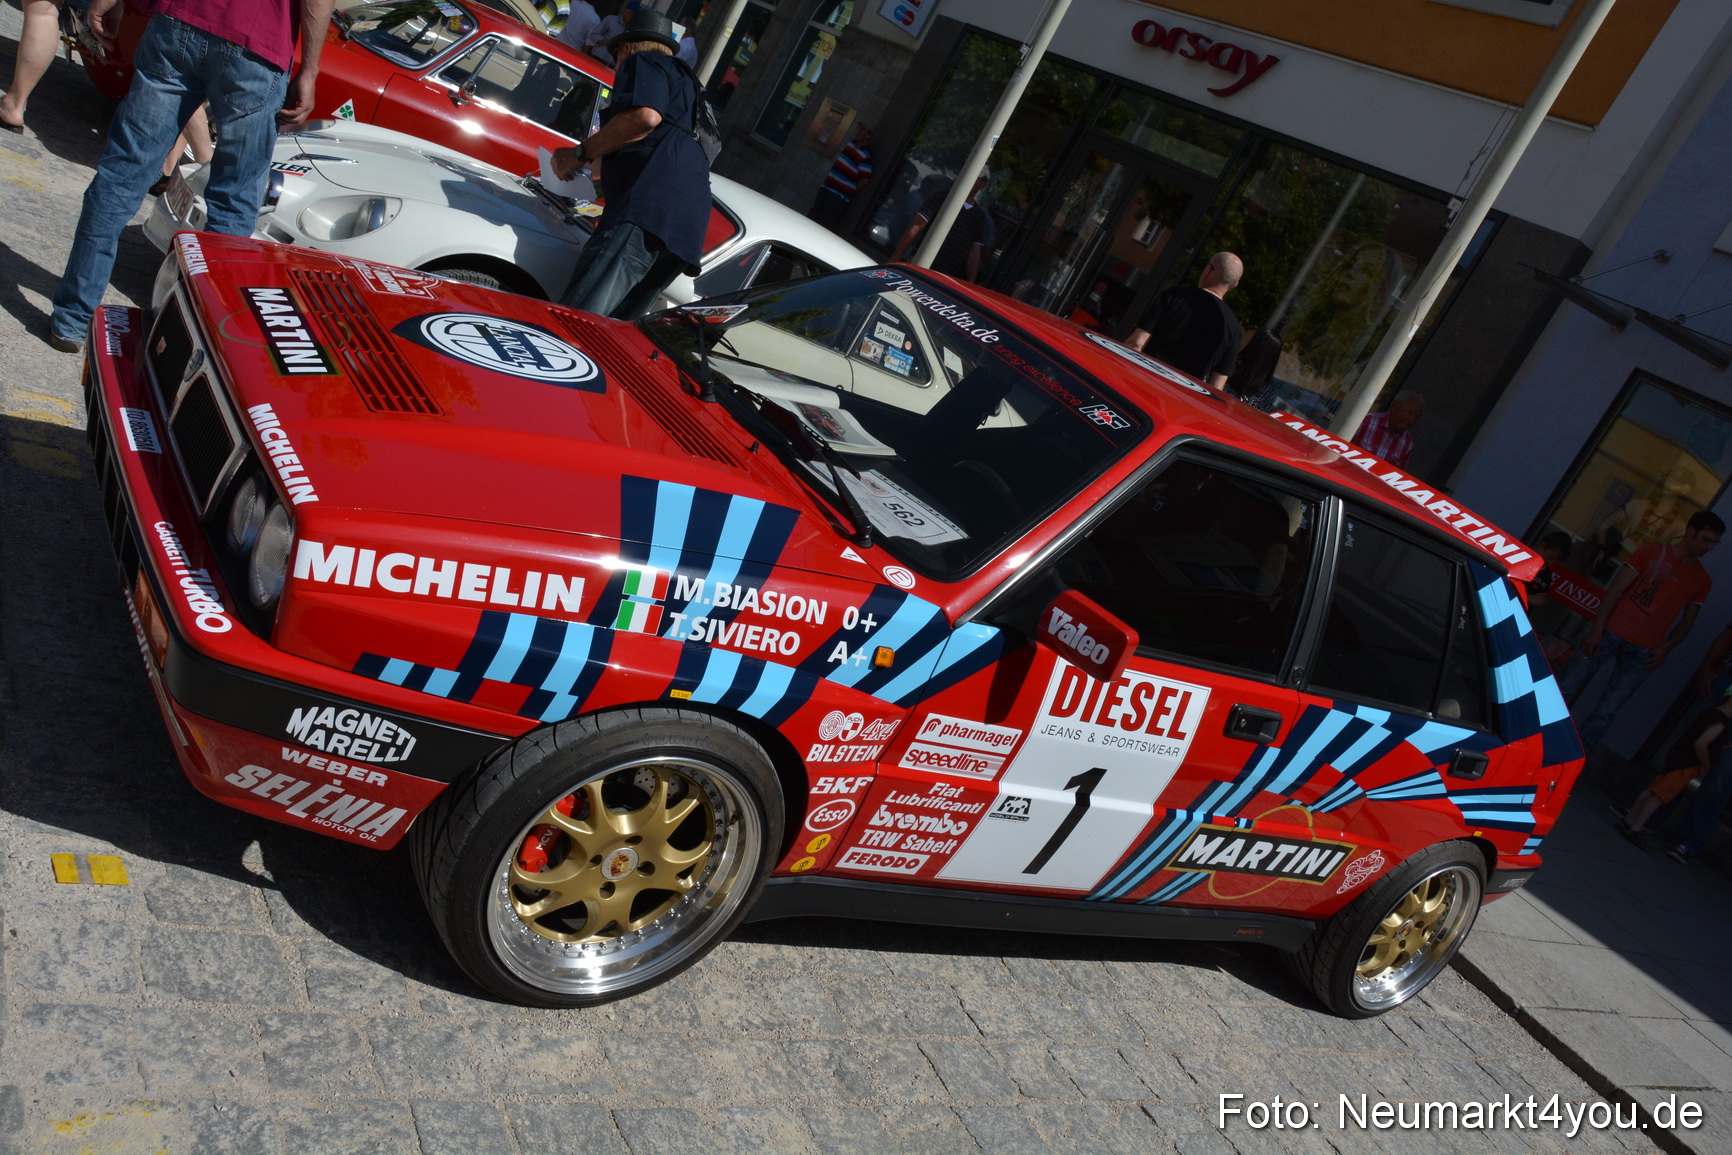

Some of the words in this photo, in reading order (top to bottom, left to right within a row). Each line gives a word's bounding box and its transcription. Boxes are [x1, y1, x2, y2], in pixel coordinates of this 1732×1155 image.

[1131, 19, 1280, 98] orsay
[177, 232, 209, 277] MICHELIN
[246, 287, 329, 374] MARTINI
[885, 279, 1000, 345] Powerdelta.de
[1023, 363, 1082, 407] excellence
[247, 402, 319, 505] MICHELIN
[1269, 412, 1378, 475] LANCIA
[1378, 471, 1532, 565] MARTINI
[882, 502, 925, 528] 562
[153, 520, 192, 567] GARRETT
[175, 567, 233, 634] TURBO
[292, 538, 586, 614] MICHELIN
[1554, 578, 1601, 613] INSID
[673, 574, 828, 626] M.BIASION
[669, 611, 801, 656] T.SIVIERO
[827, 640, 868, 667] A+
[1047, 606, 1111, 665] Valeo
[1048, 664, 1193, 741] DIESEL
[285, 706, 417, 748] MAGNETI
[286, 726, 417, 763] MARELLI
[938, 722, 1019, 747] pharmagel
[1040, 724, 1083, 742] JEANS
[1087, 732, 1096, 744] &
[1101, 735, 1181, 758] SPORTSWEAR
[281, 746, 389, 788] WEBER
[806, 743, 885, 763] BILSTEIN
[905, 748, 989, 774] speedline
[809, 776, 875, 794] SKF
[884, 790, 986, 815] Lubrificanti
[928, 781, 965, 799] Fiat
[311, 815, 355, 835] MOTOR
[358, 832, 378, 844] OIL
[858, 828, 904, 848] TRW
[900, 833, 959, 855] Sabelt
[868, 804, 969, 837] brembo
[1022, 767, 1108, 875] 1
[844, 851, 921, 870] FERODO
[1177, 833, 1346, 878] MARTINI
